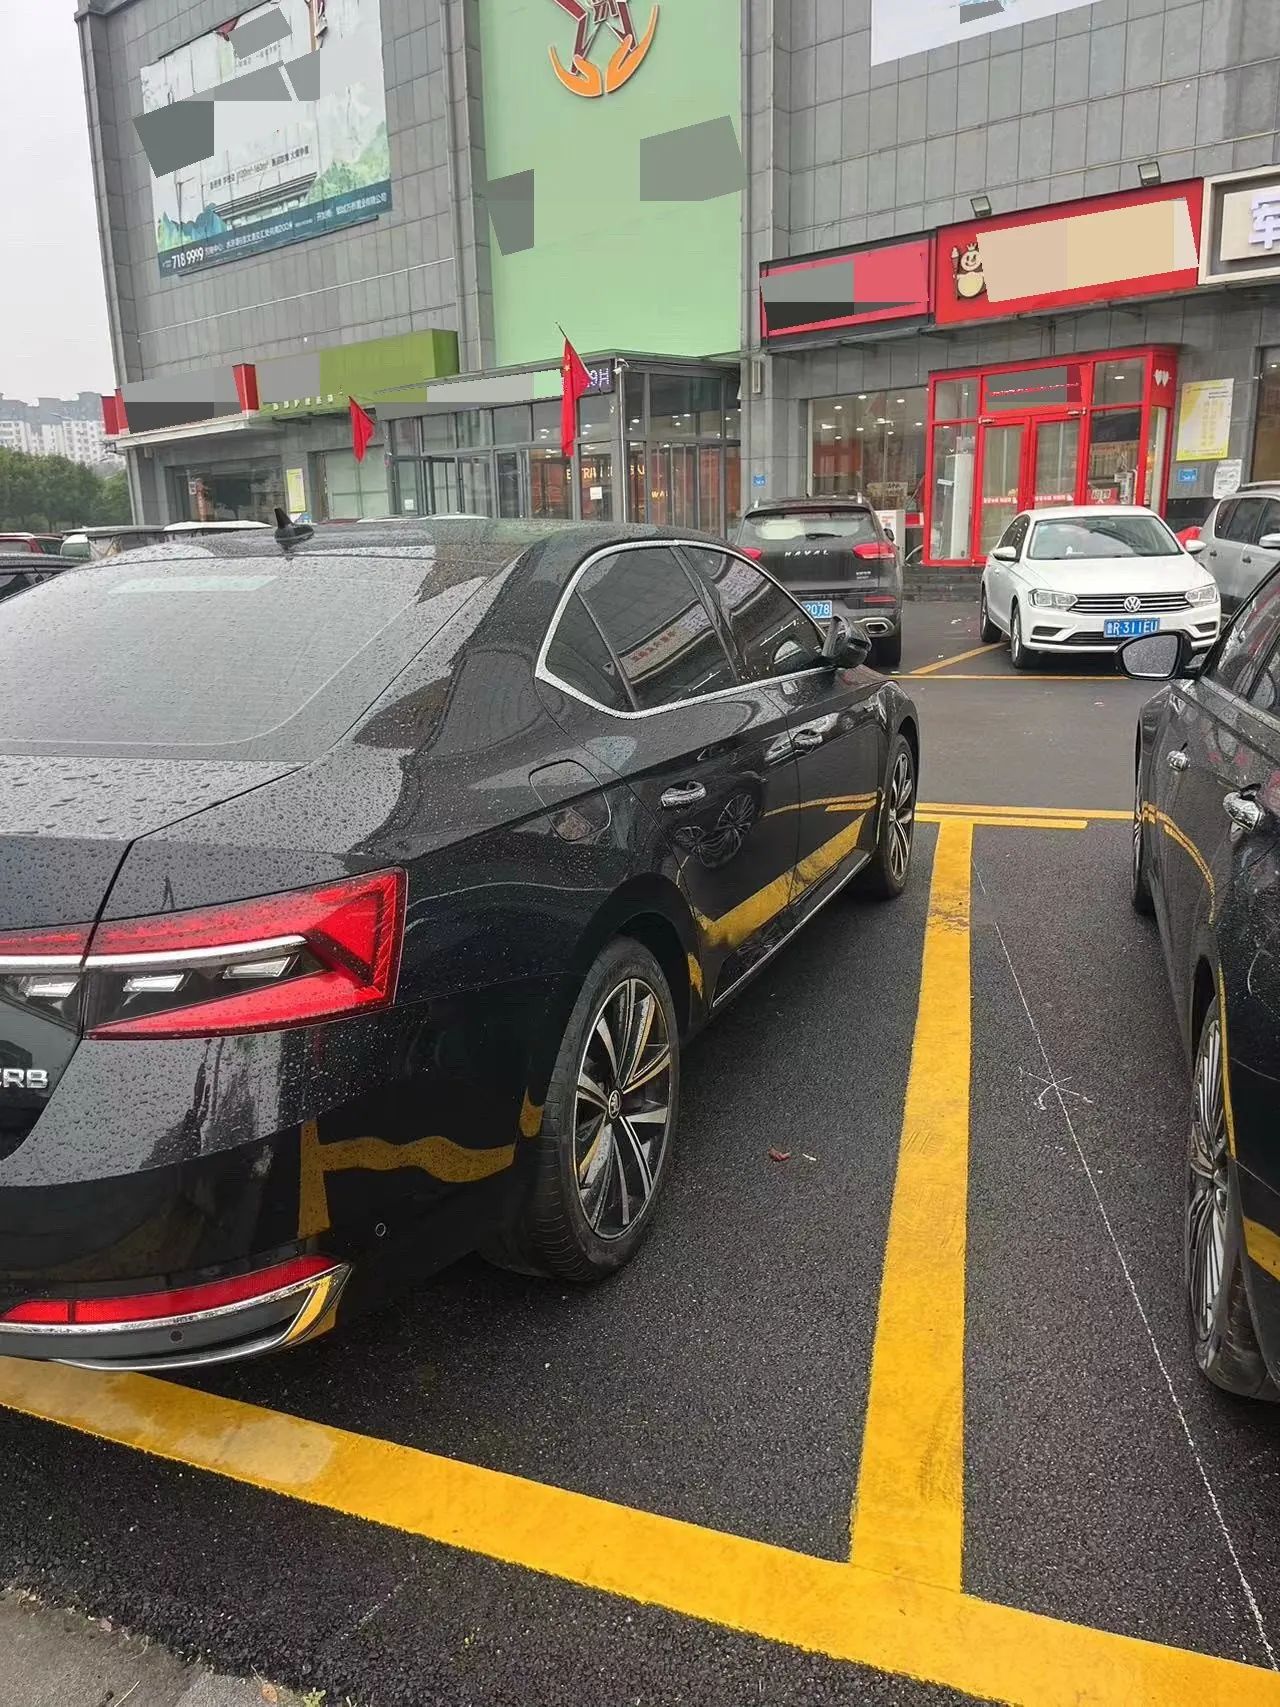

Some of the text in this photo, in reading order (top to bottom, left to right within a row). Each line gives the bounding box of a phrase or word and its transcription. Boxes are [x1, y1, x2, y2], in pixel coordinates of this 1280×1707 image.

[171, 254, 186, 269] 718
[186, 247, 204, 265] 9999
[784, 549, 830, 557] HAVAL
[0, 1068, 49, 1089] RB
